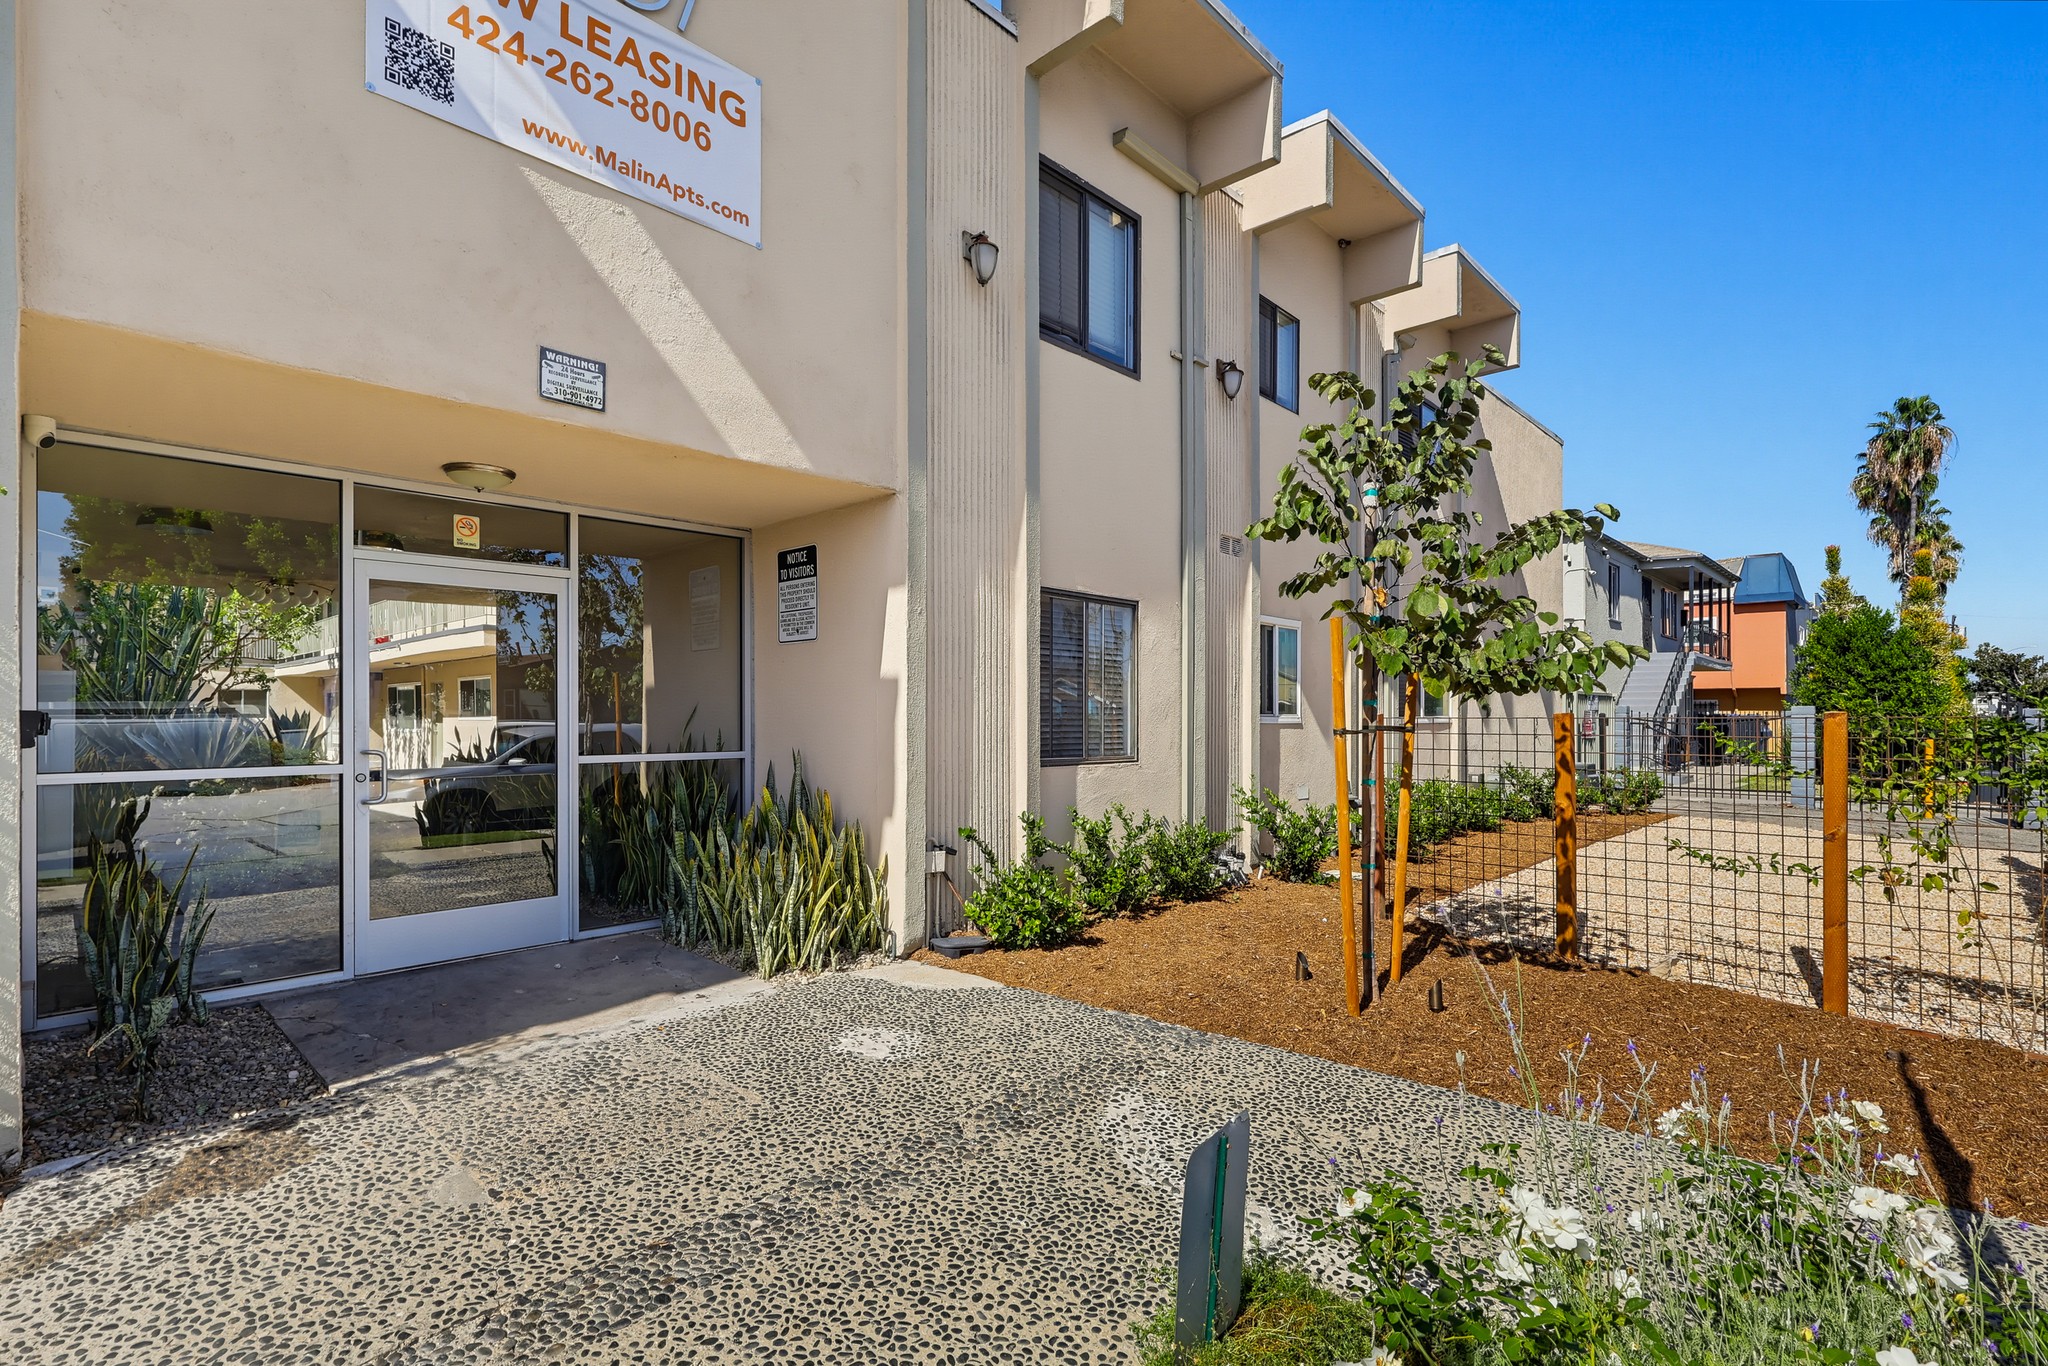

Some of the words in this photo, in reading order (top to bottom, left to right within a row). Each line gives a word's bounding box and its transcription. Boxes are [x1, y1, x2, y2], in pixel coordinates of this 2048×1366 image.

[447, 5, 712, 152] 424-262-8006
[559, 2, 747, 128] LEASING
[522, 118, 749, 227] www.MalinApts.com
[546, 351, 599, 372] WARNING!
[780, 569, 787, 580] TO
[788, 564, 815, 579] VISITORS
[787, 551, 807, 564] NOTICE
